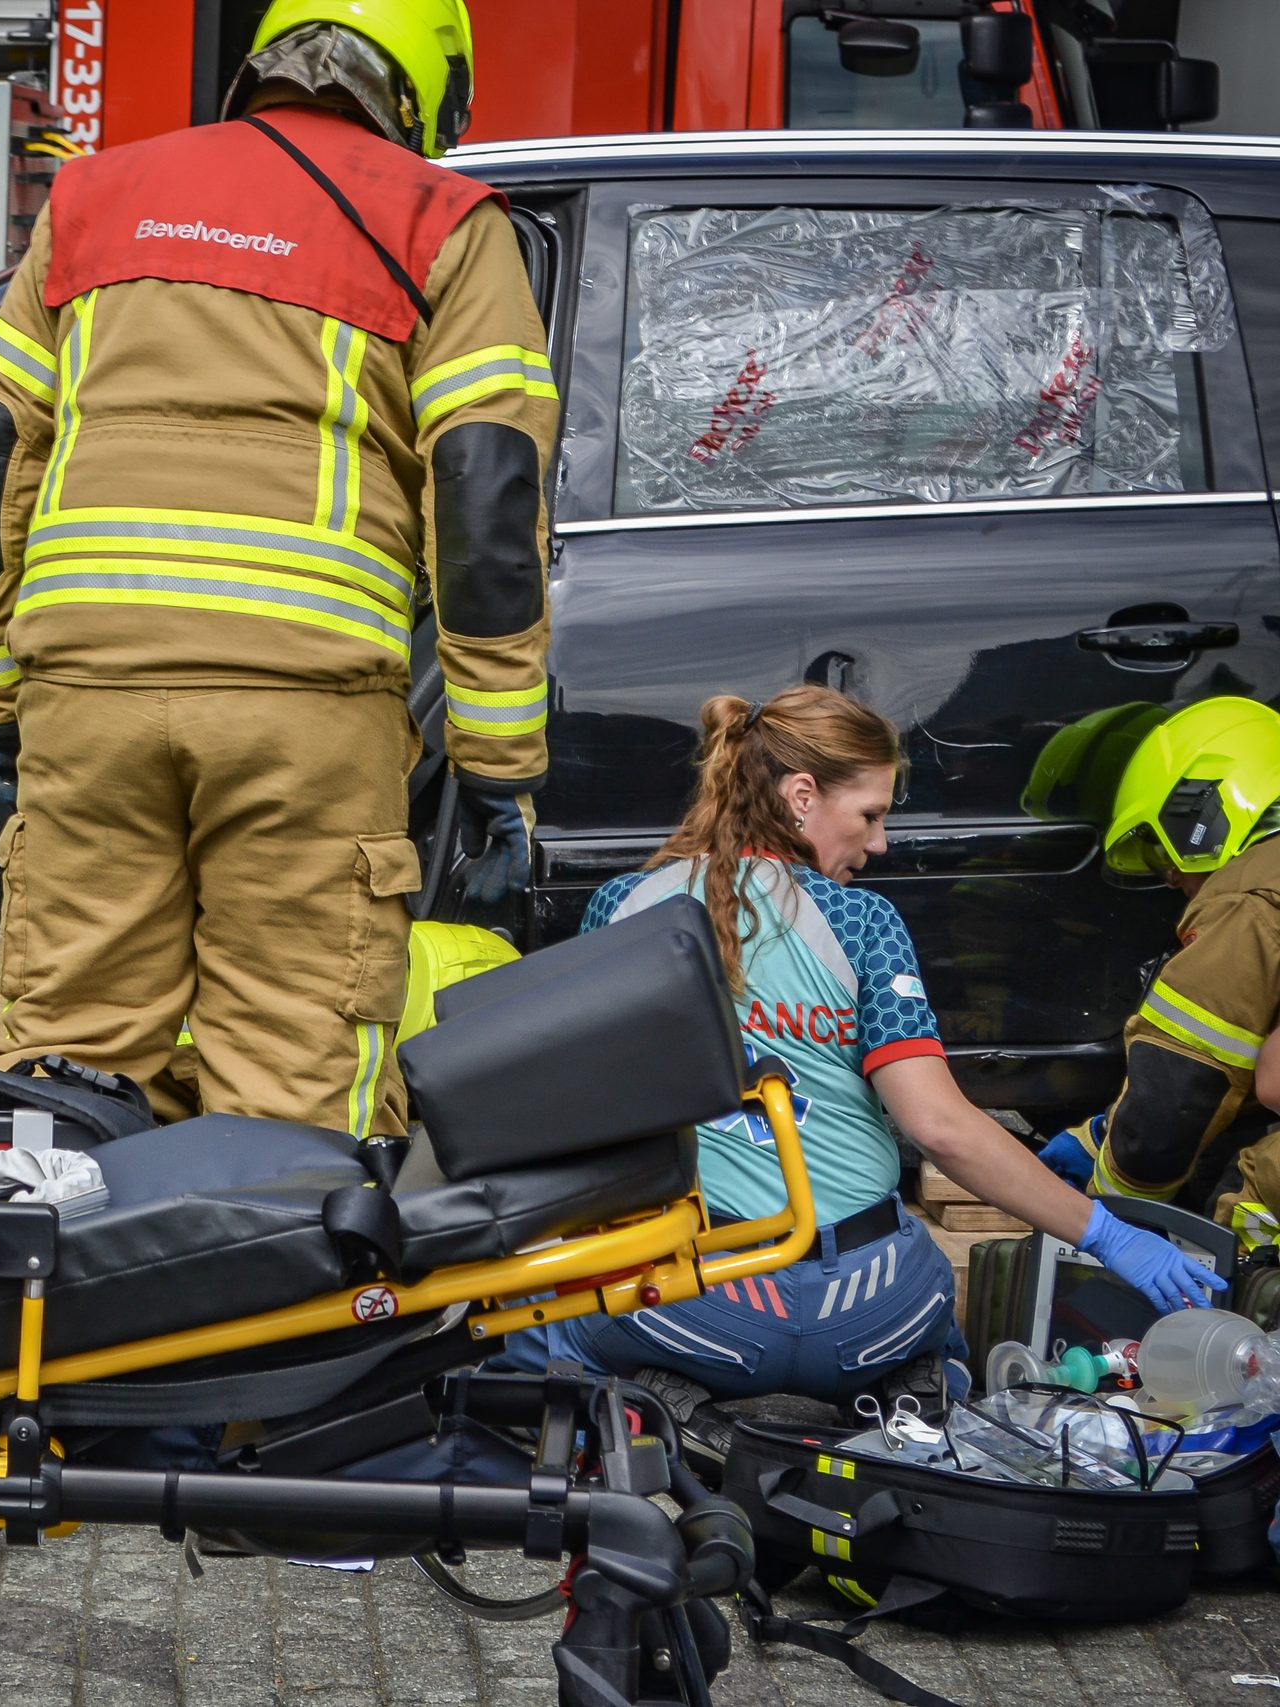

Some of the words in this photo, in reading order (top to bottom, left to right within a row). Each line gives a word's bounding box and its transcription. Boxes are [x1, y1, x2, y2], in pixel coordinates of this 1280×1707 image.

[63, 0, 103, 157] 17-333
[134, 218, 298, 257] Bevelvoerder
[740, 1000, 859, 1046] ANCE
